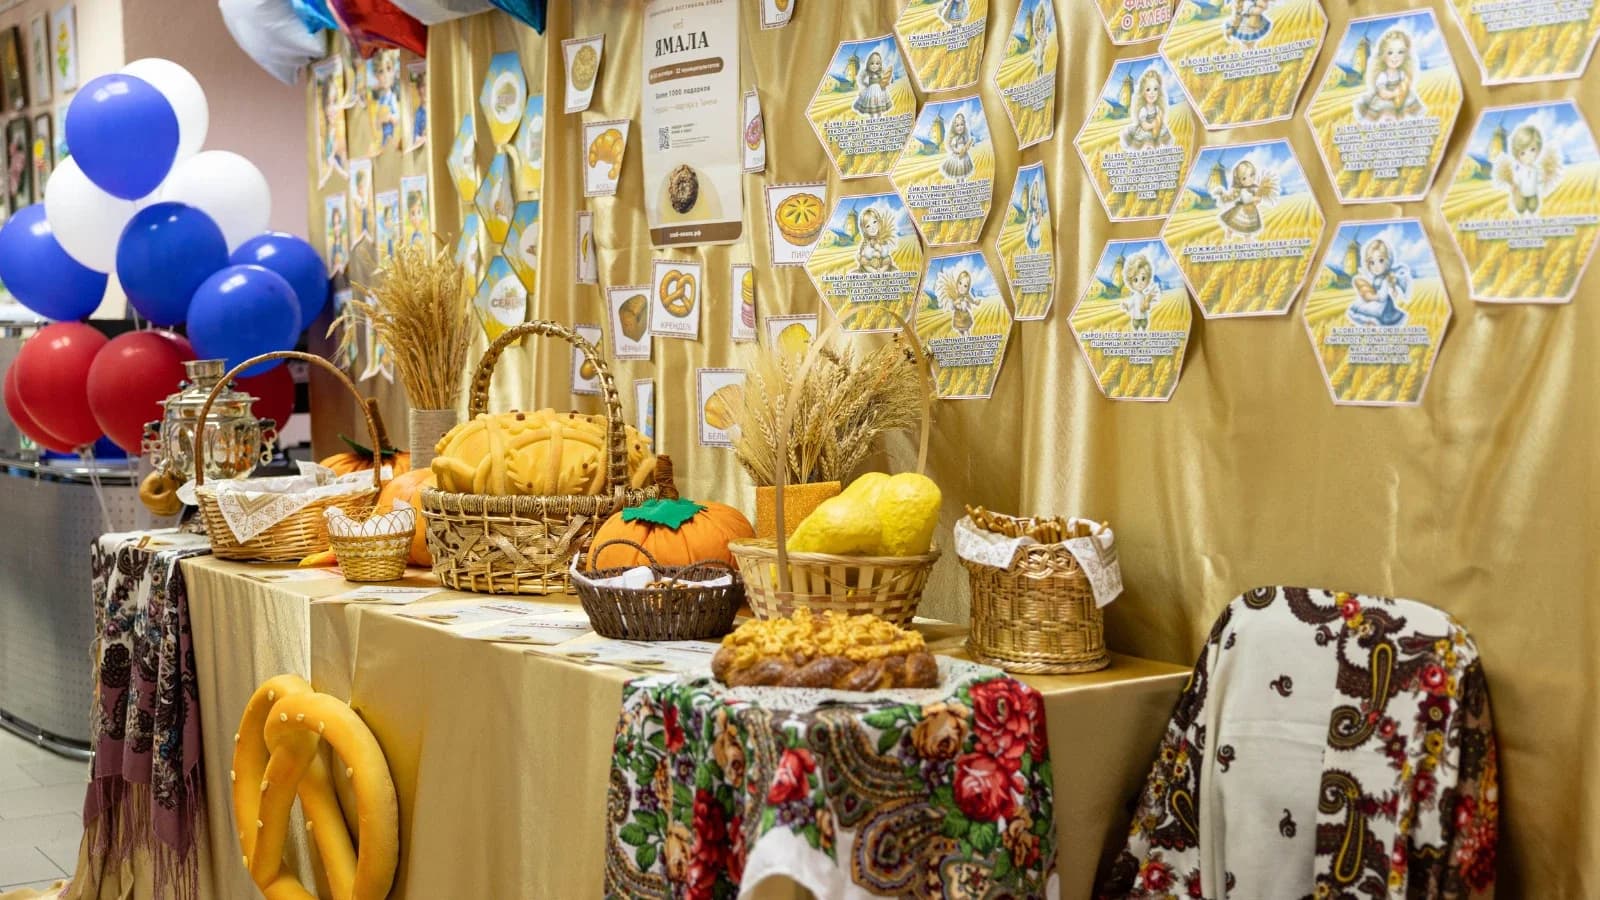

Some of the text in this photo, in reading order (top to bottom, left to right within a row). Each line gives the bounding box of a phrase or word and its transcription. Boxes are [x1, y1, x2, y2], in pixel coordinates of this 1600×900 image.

[1123, 7, 1170, 28] О ХЛЕБЕ
[655, 31, 709, 56] ЯМАЛА
[1217, 57, 1272, 70] ТРАДИЦИОННЫЕ
[1275, 52, 1302, 61] РЕЦЕПТЫ
[1242, 48, 1271, 58] СТРАНАХ
[1192, 254, 1231, 262] ПРИМЕНЯТЬ
